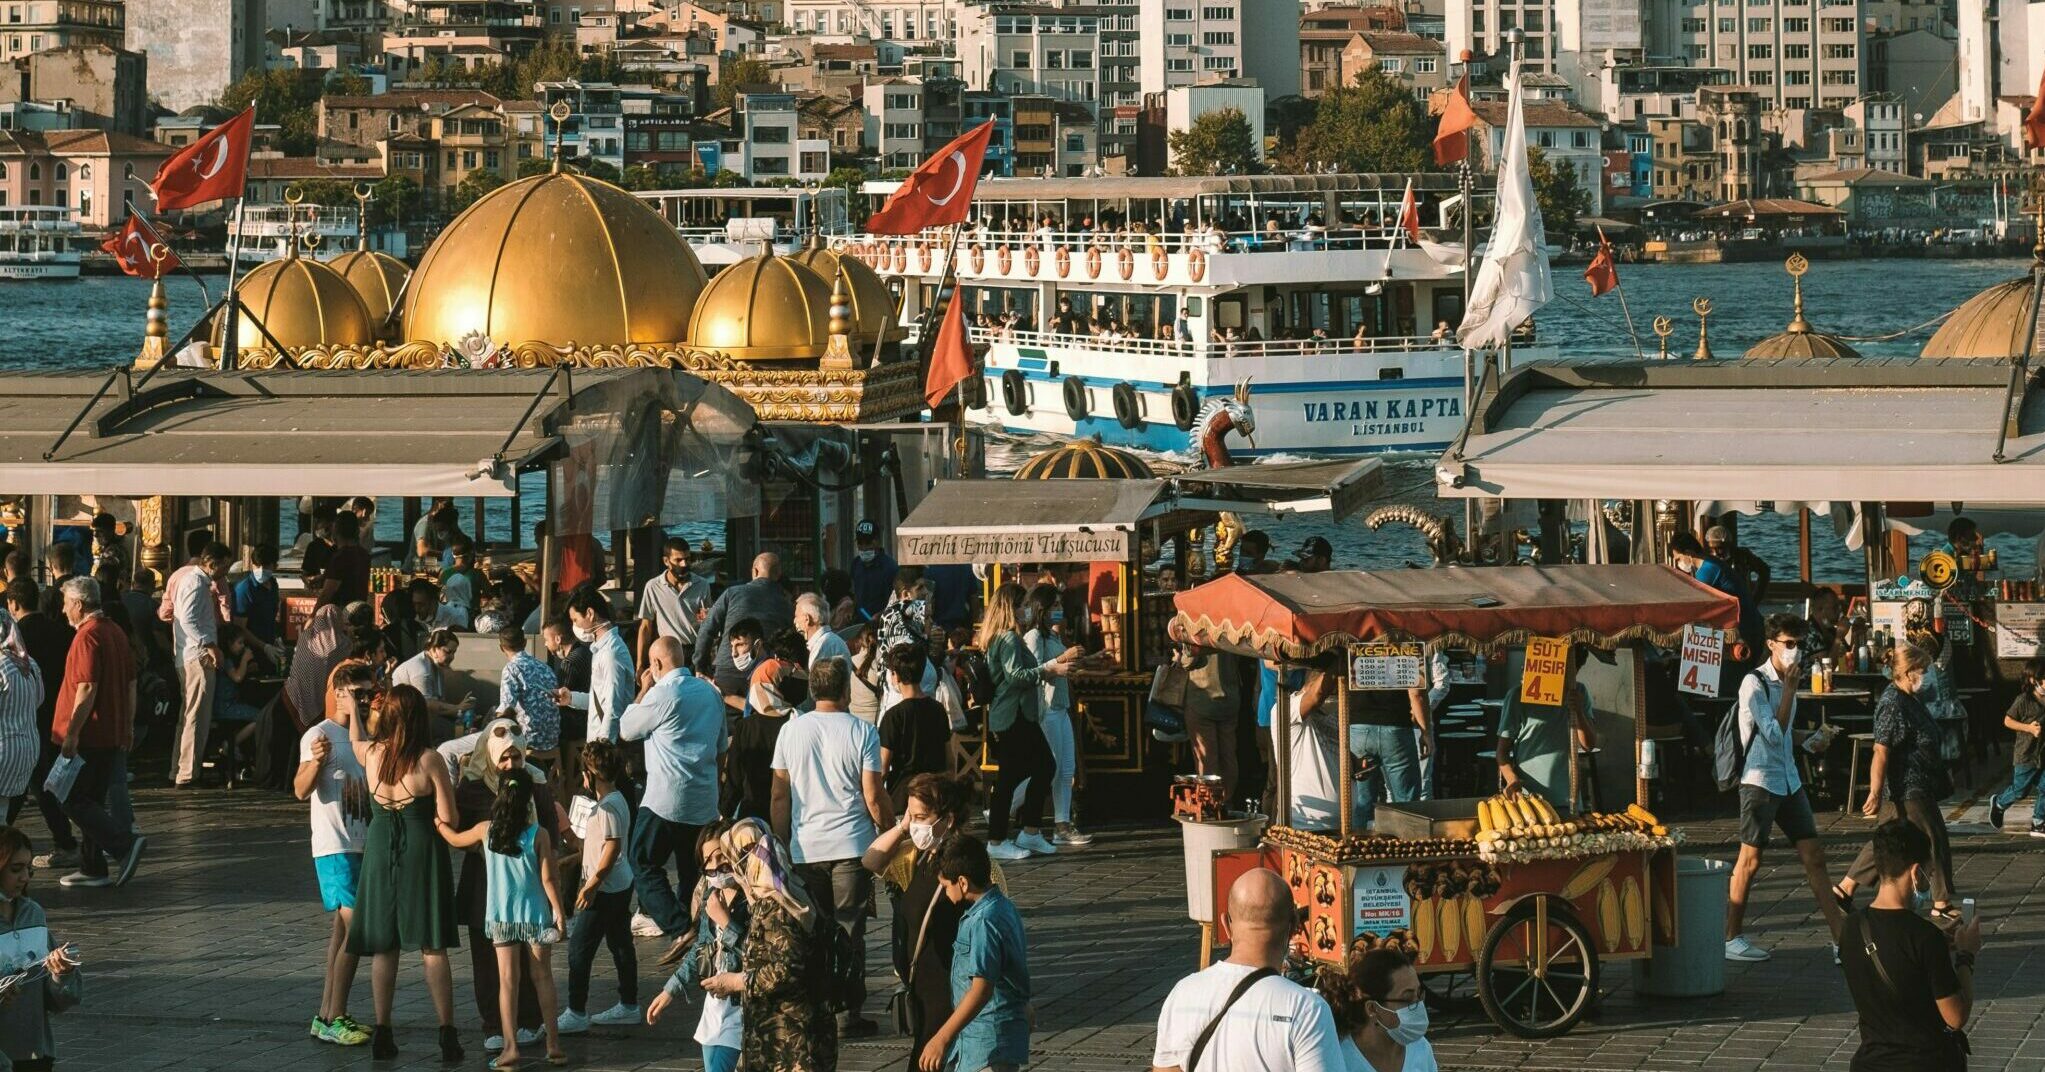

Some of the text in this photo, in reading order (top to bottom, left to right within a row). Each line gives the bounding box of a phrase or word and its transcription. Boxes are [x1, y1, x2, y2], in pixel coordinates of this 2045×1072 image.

[1304, 398, 1466, 422] VARAN KAPTA
[908, 534, 1121, 558] Tarihi Eminönü Turşucusu
[1355, 646, 1419, 656] KESTANE
[1532, 641, 1561, 658] SÜT
[1683, 647, 1721, 666] MISIR
[1525, 659, 1565, 675] MISIR
[1526, 675, 1559, 702] 4 TL
[1683, 665, 1715, 693] 4 TL
